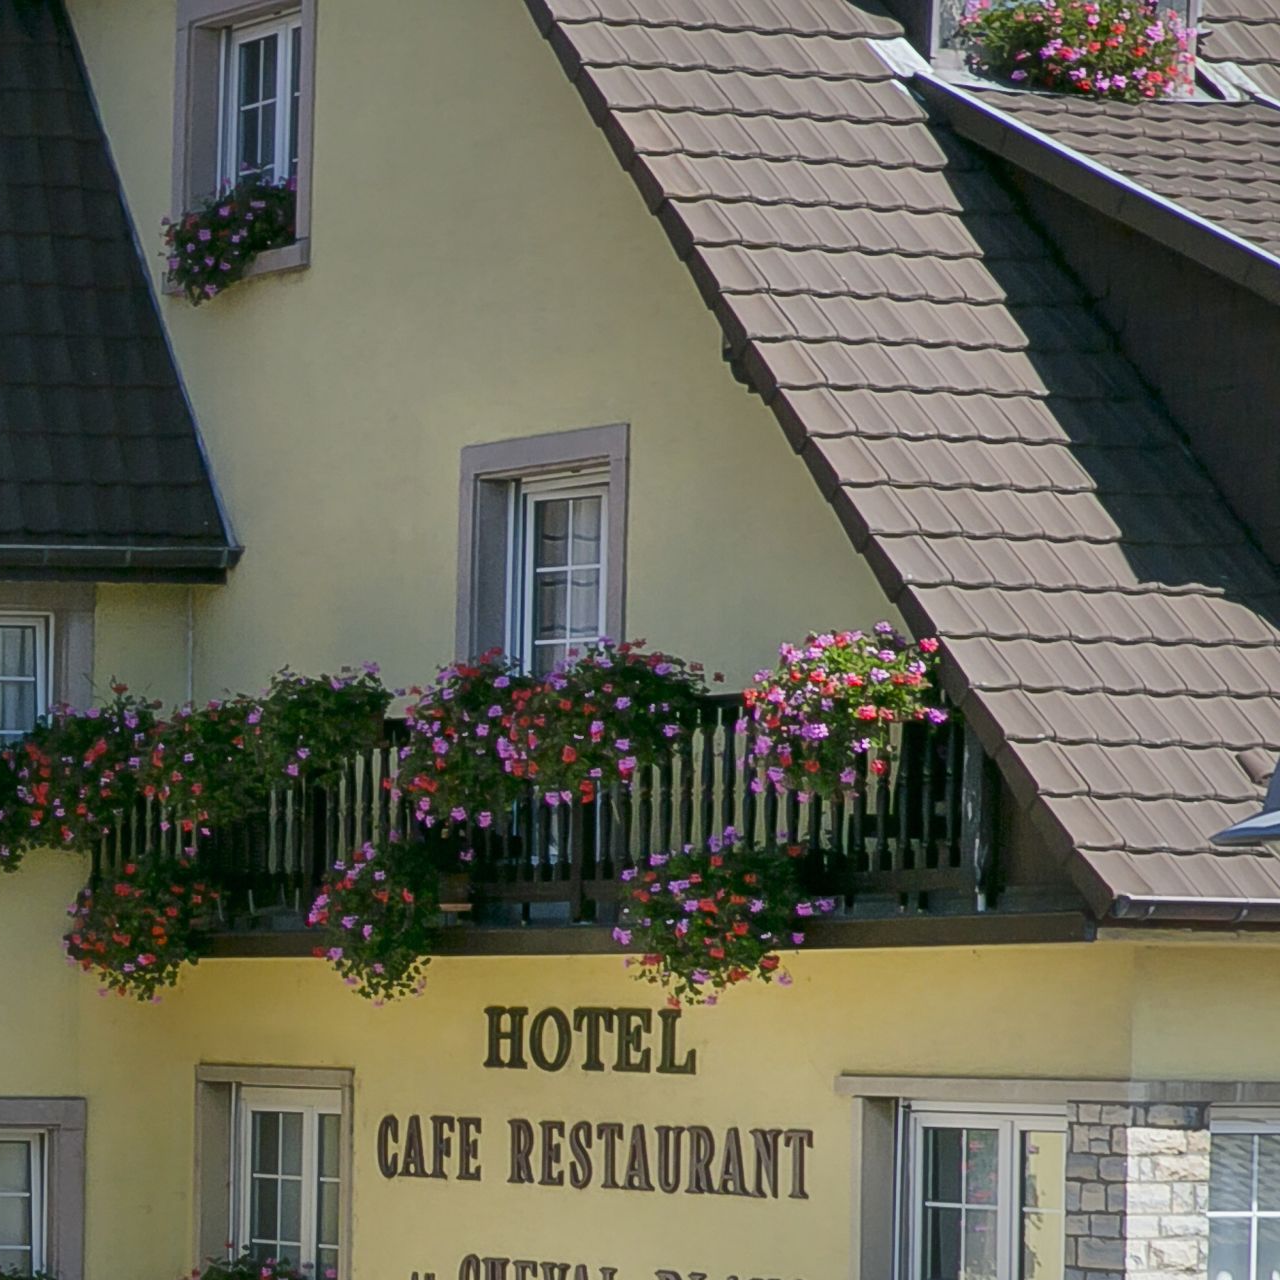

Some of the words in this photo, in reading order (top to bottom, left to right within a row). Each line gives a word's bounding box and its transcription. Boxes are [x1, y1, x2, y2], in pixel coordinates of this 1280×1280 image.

[483, 1006, 697, 1075] HOTEL
[377, 1114, 482, 1181] CAFE
[507, 1118, 814, 1199] RESTAURANT
